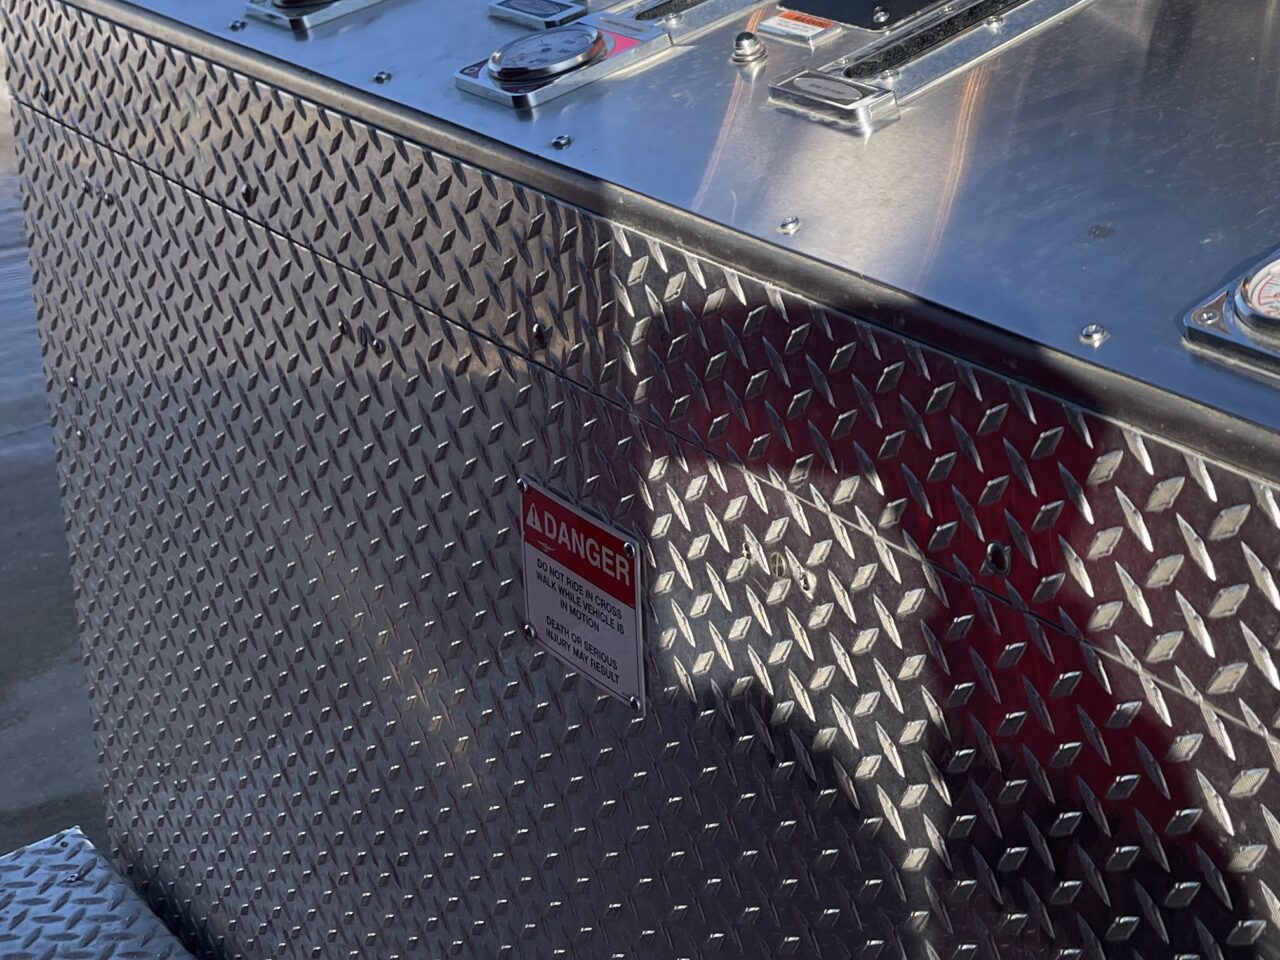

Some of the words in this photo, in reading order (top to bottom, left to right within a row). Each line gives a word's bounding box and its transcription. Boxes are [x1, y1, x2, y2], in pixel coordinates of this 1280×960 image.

[543, 510, 630, 586] DANGER
[536, 570, 557, 591] WALK
[558, 584, 582, 607] WHILE
[583, 600, 616, 629] VEHICLE
[616, 621, 625, 635] IS
[537, 558, 548, 572] DO
[549, 565, 564, 583] NOT
[566, 576, 584, 596] RIDE
[585, 589, 593, 601] IN
[594, 595, 622, 619] CROSS
[560, 599, 568, 612] IN
[569, 604, 600, 632] MOTION
[545, 627, 571, 652] INJURY
[573, 646, 589, 664] MAY
[590, 658, 620, 685] RESULT
[546, 615, 570, 638] DEATH
[571, 632, 583, 648] OR
[583, 640, 618, 670] SERIOUS
